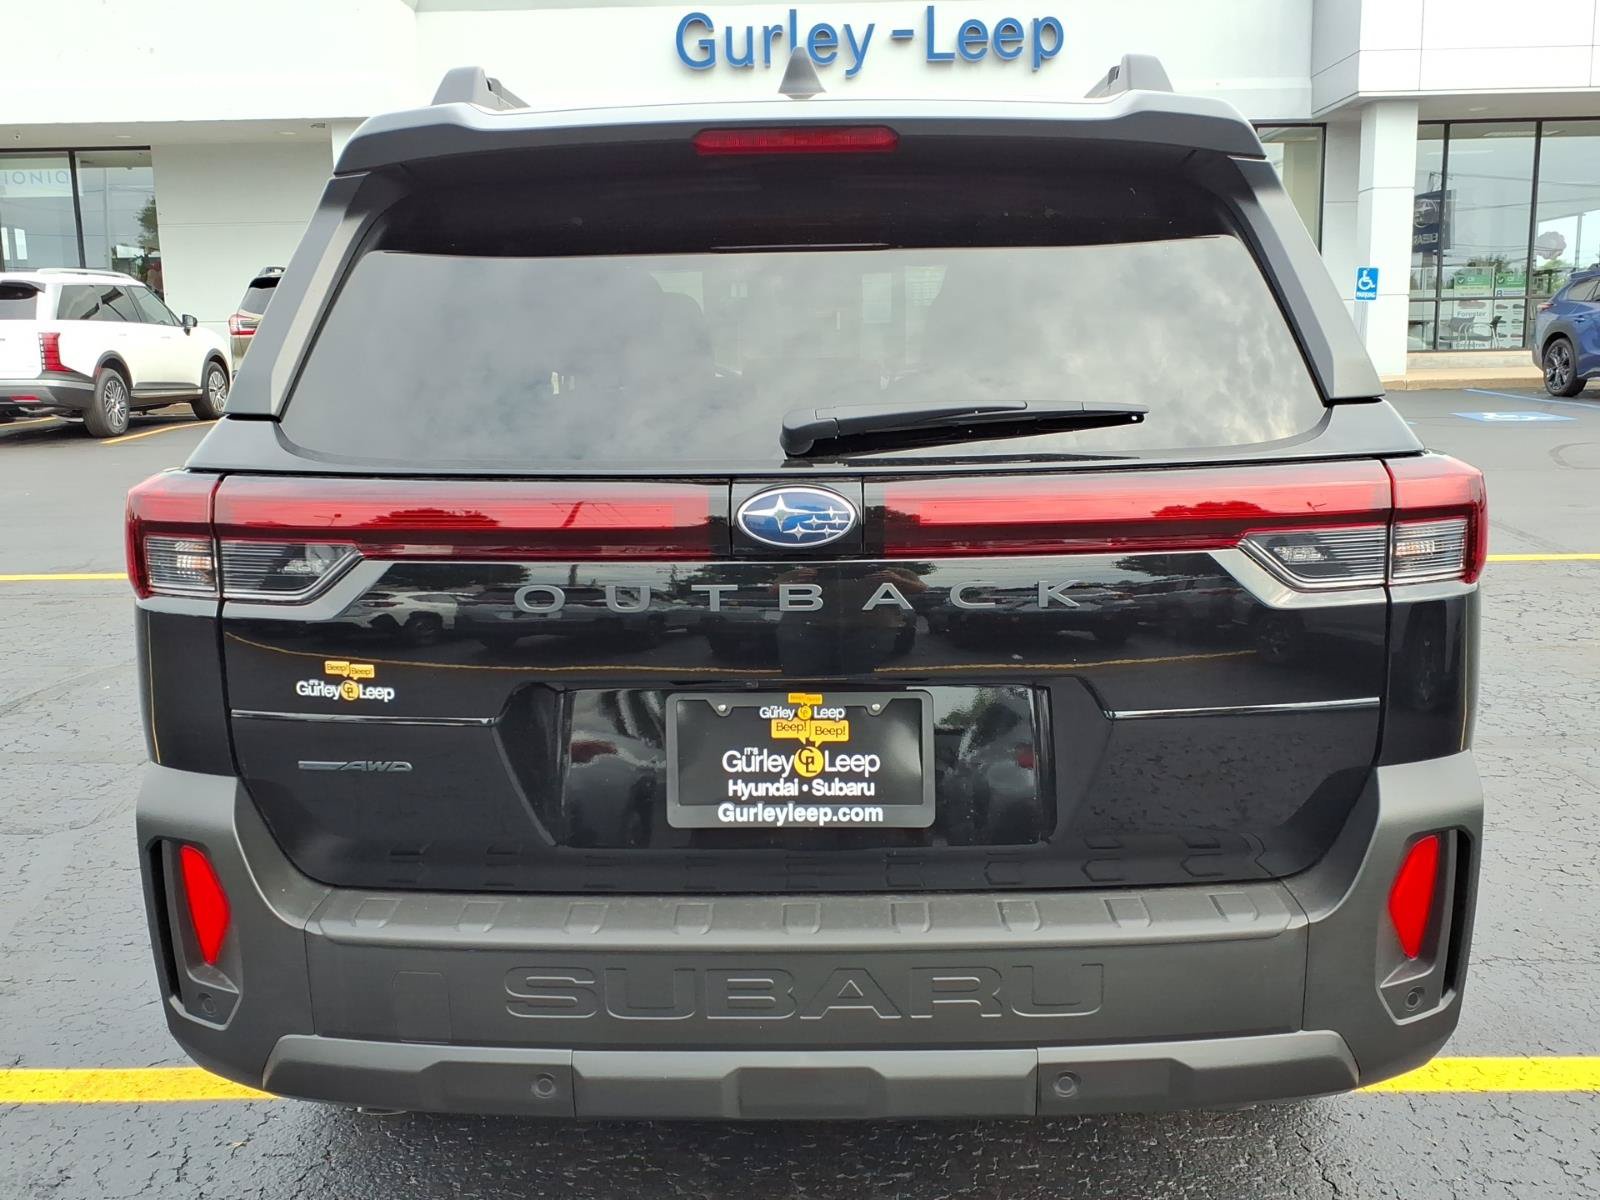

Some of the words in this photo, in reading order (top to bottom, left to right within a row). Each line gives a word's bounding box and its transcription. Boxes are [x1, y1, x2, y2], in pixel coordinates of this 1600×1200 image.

[675, 9, 875, 78] Gurley
[925, 5, 1064, 72] Leep
[513, 580, 1081, 613] OUTBACK
[296, 680, 340, 700] Gurley
[359, 684, 395, 702] Leep
[759, 706, 795, 720] Gurley
[813, 706, 845, 721] Leep
[776, 721, 807, 733] Beep!
[815, 725, 845, 737] Beep!
[340, 760, 413, 772] AWD
[722, 748, 794, 777] Gurley
[824, 750, 880, 777] Leep
[728, 778, 799, 800] Hyundai
[811, 777, 875, 796] Subaru
[717, 802, 883, 826] Gurleyleep.com
[504, 963, 1104, 1020] SUBARU
